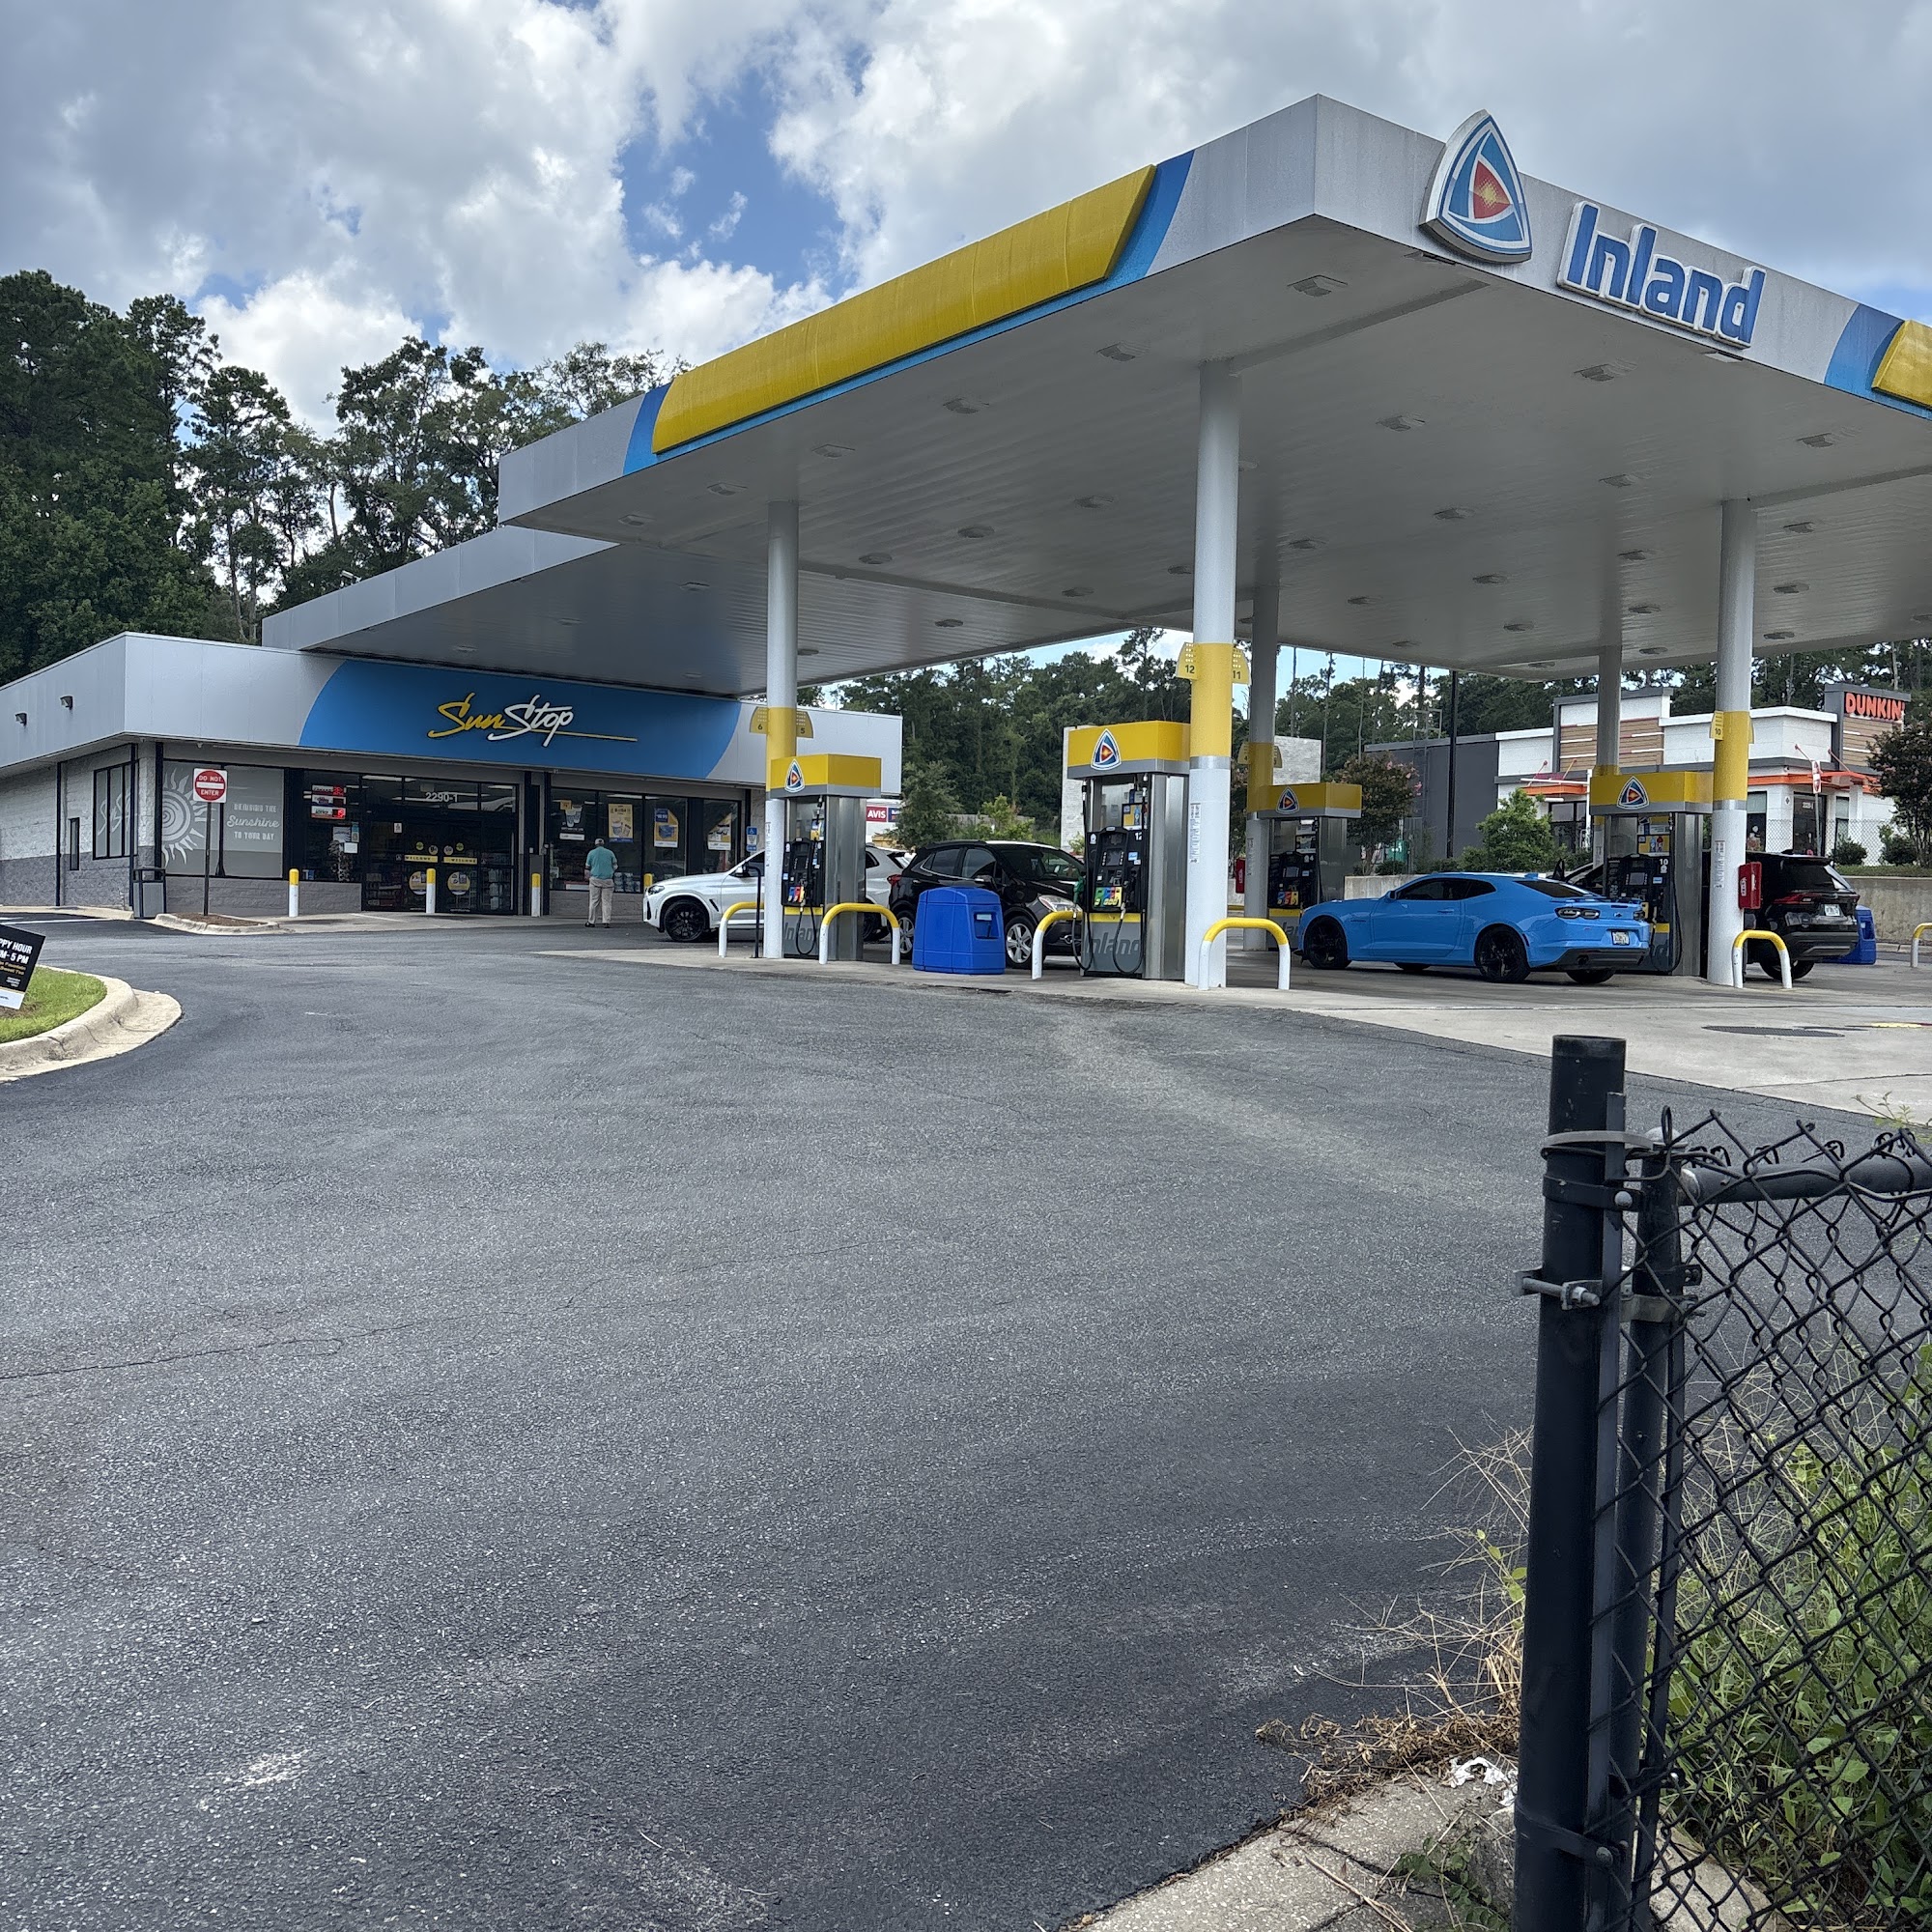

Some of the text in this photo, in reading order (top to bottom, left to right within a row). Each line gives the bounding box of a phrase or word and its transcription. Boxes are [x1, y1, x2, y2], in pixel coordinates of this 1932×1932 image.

[1563, 202, 1767, 346] Inland
[1184, 664, 1195, 674] 12
[1232, 669, 1241, 679] 11
[1845, 692, 1906, 721] DUNKIN'
[425, 791, 459, 803] 2290-1
[867, 810, 886, 819] AVIS
[226, 814, 280, 828] Sunshine
[244, 832, 261, 840] YOUR
[12, 942, 33, 954] HOUR
[11, 952, 17, 961] 5
[16, 954, 29, 964] PM
